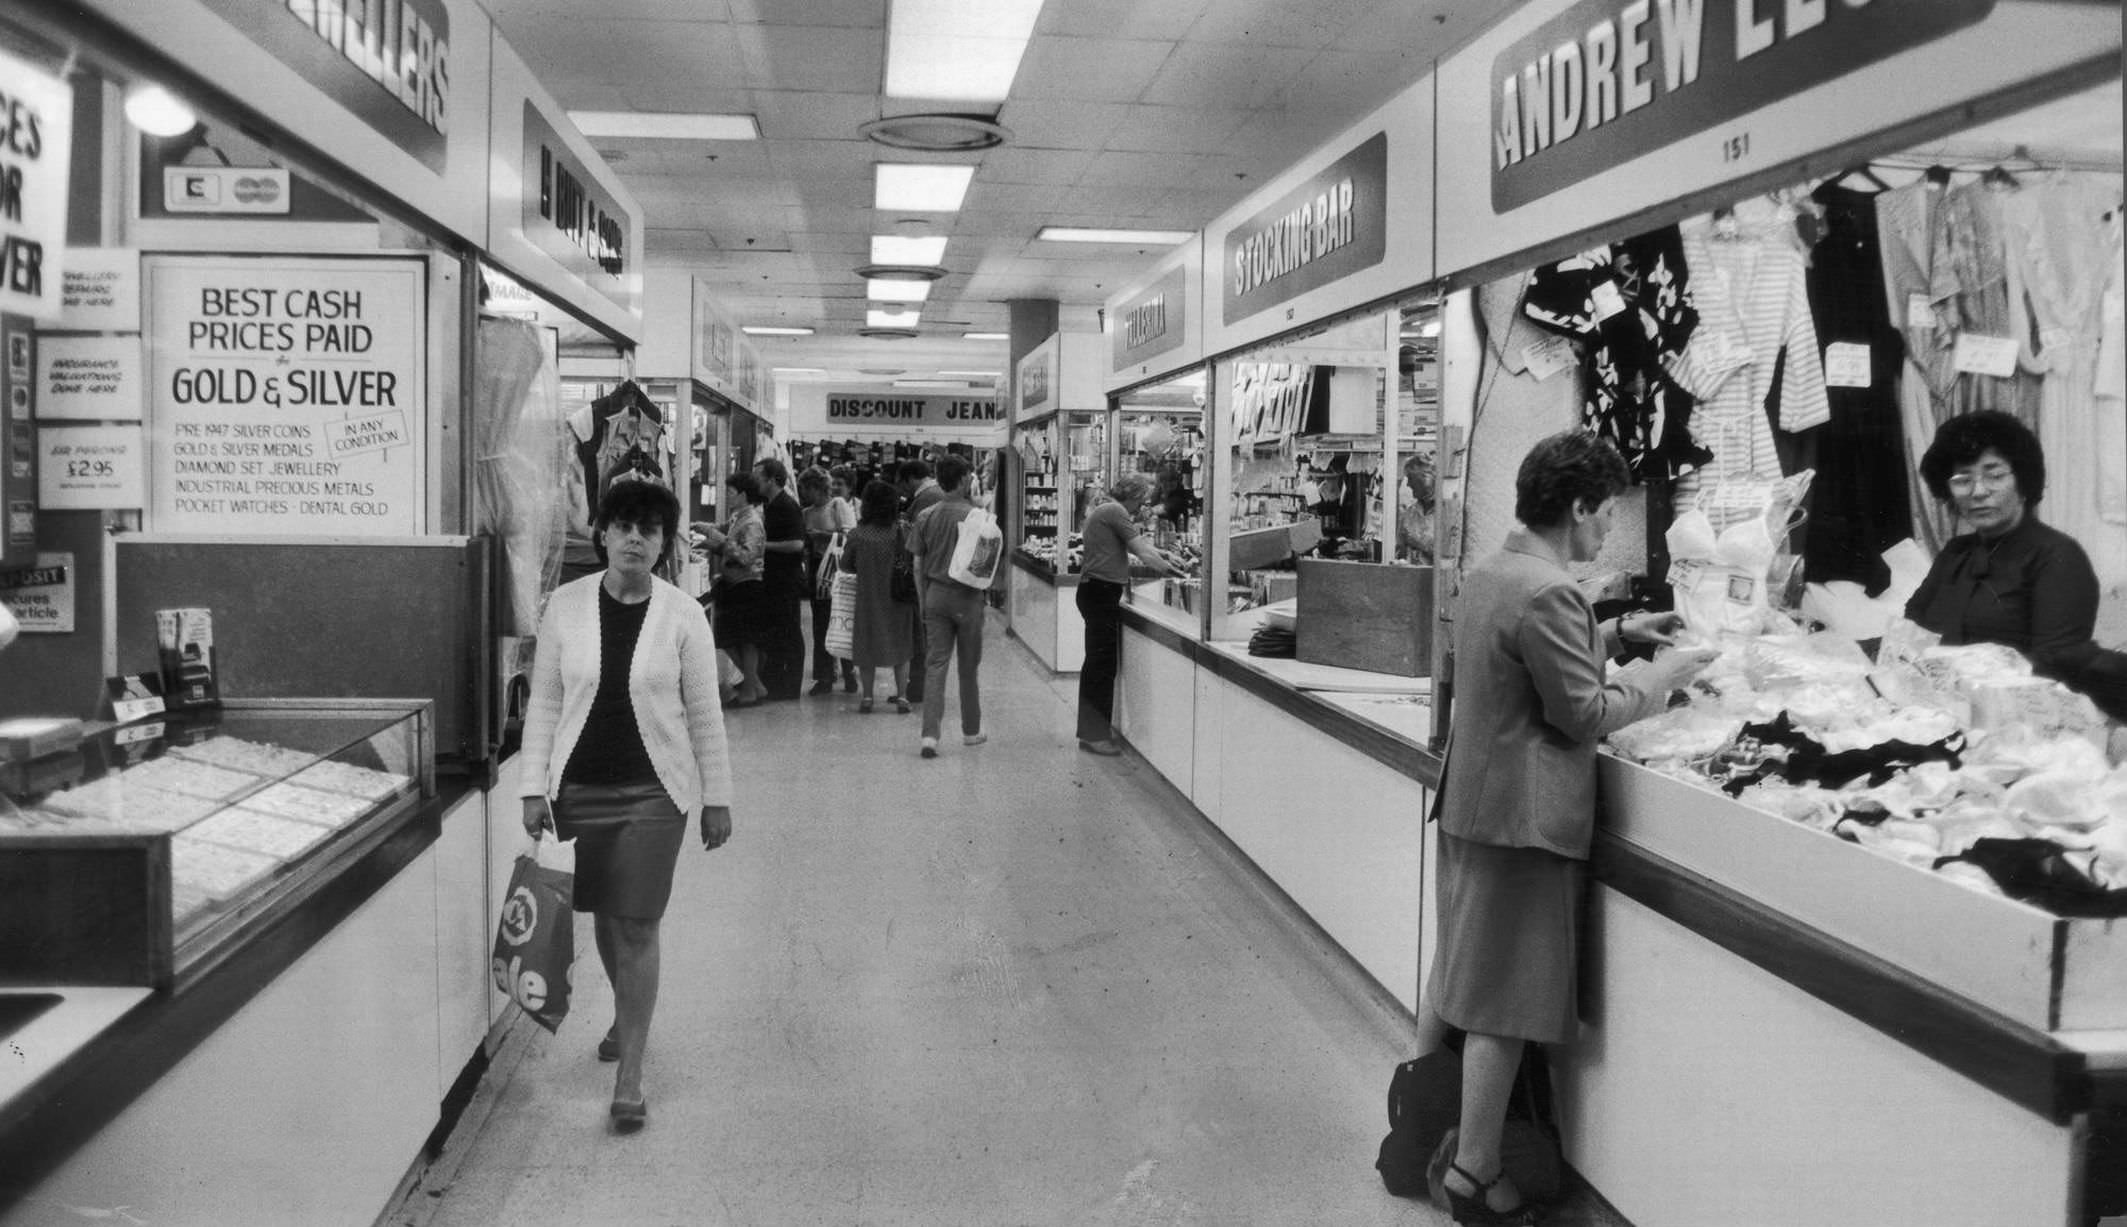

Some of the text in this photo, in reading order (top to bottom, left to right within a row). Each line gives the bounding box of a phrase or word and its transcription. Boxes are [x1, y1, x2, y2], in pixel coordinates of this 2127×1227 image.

[1498, 0, 1701, 171] ANDREW
[1723, 132, 1749, 163] 151
[1235, 178, 1354, 296] STOCKING BAR
[201, 288, 361, 319] BEST CASH
[189, 321, 373, 353] PRICES PAID
[172, 368, 397, 409] GOLD & SILVER
[830, 400, 926, 419] DISCOUNT
[175, 424, 311, 438] PRE 1947 SILVER COINS
[345, 418, 384, 435] IN ANY
[175, 443, 208, 456] GOLD
[221, 443, 260, 456] SILVER
[264, 443, 313, 457] MEDALS
[335, 430, 399, 451] CONDITION
[175, 461, 341, 476] DIAMOND SET JEWELLERY
[175, 480, 375, 496] INDUSTRIAL PRECIOUS METALS
[175, 499, 388, 516] POCKET WATCHES DENTAL GOLD
